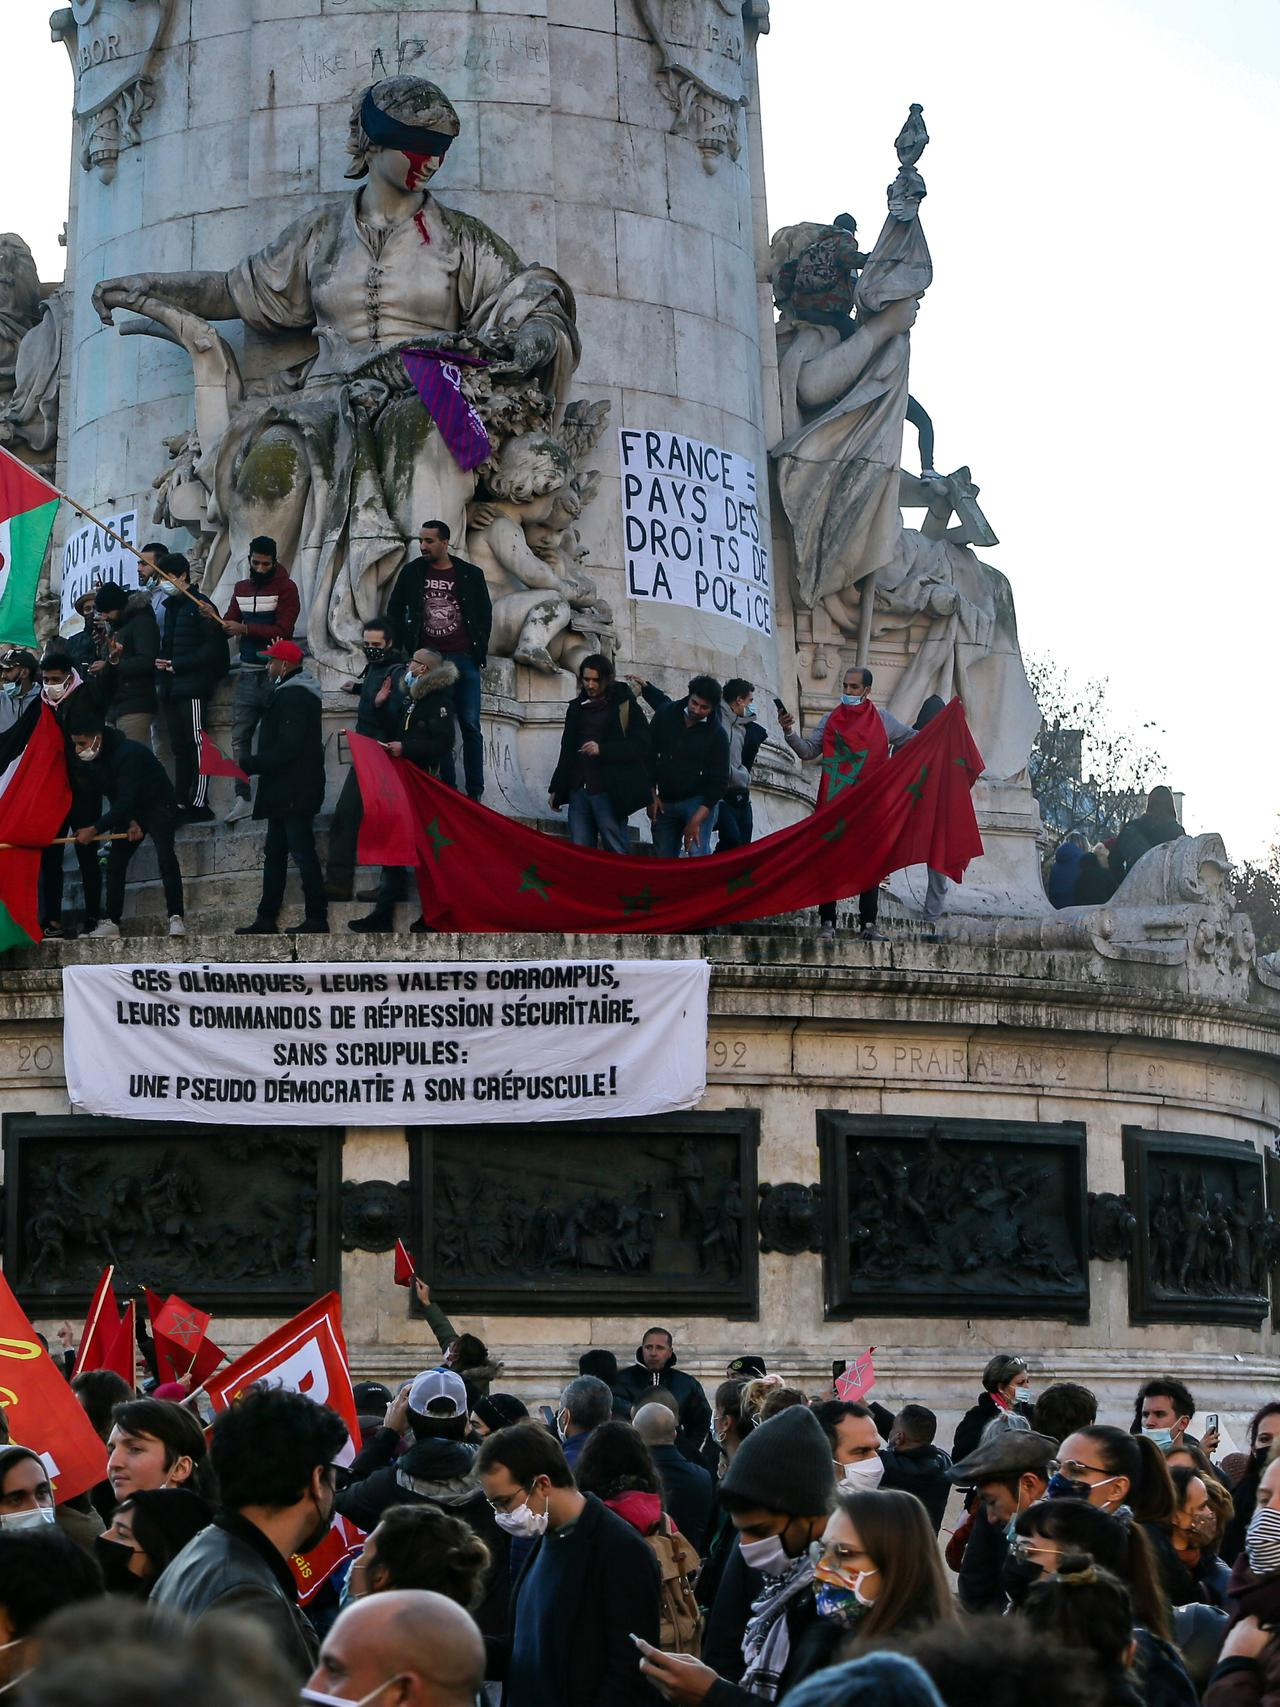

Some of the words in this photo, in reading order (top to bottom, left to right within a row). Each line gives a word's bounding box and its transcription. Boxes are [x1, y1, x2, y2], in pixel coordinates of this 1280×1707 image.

[621, 431, 735, 492] FRANCE
[625, 474, 707, 524] PAYS
[725, 496, 759, 543] DES
[629, 560, 672, 600] LA
[753, 545, 769, 586] DE
[132, 969, 171, 992] CES
[320, 973, 388, 993] LEURS
[397, 971, 477, 992] VALETS
[486, 964, 620, 990] CORROMPUS,
[116, 1001, 180, 1026] LEURS
[189, 1006, 322, 1029] COMMANDOS
[331, 1006, 356, 1029] DE
[273, 1043, 328, 1066] SANS
[336, 1041, 468, 1066] SCRUPULES:
[855, 1045, 878, 1071] 13
[129, 1075, 170, 1098] UNE
[176, 1076, 256, 1102] PSEUDO
[402, 1079, 415, 1102] A
[425, 1078, 465, 1102] SON
[473, 1066, 617, 1101] CRÉPUSCULE!
